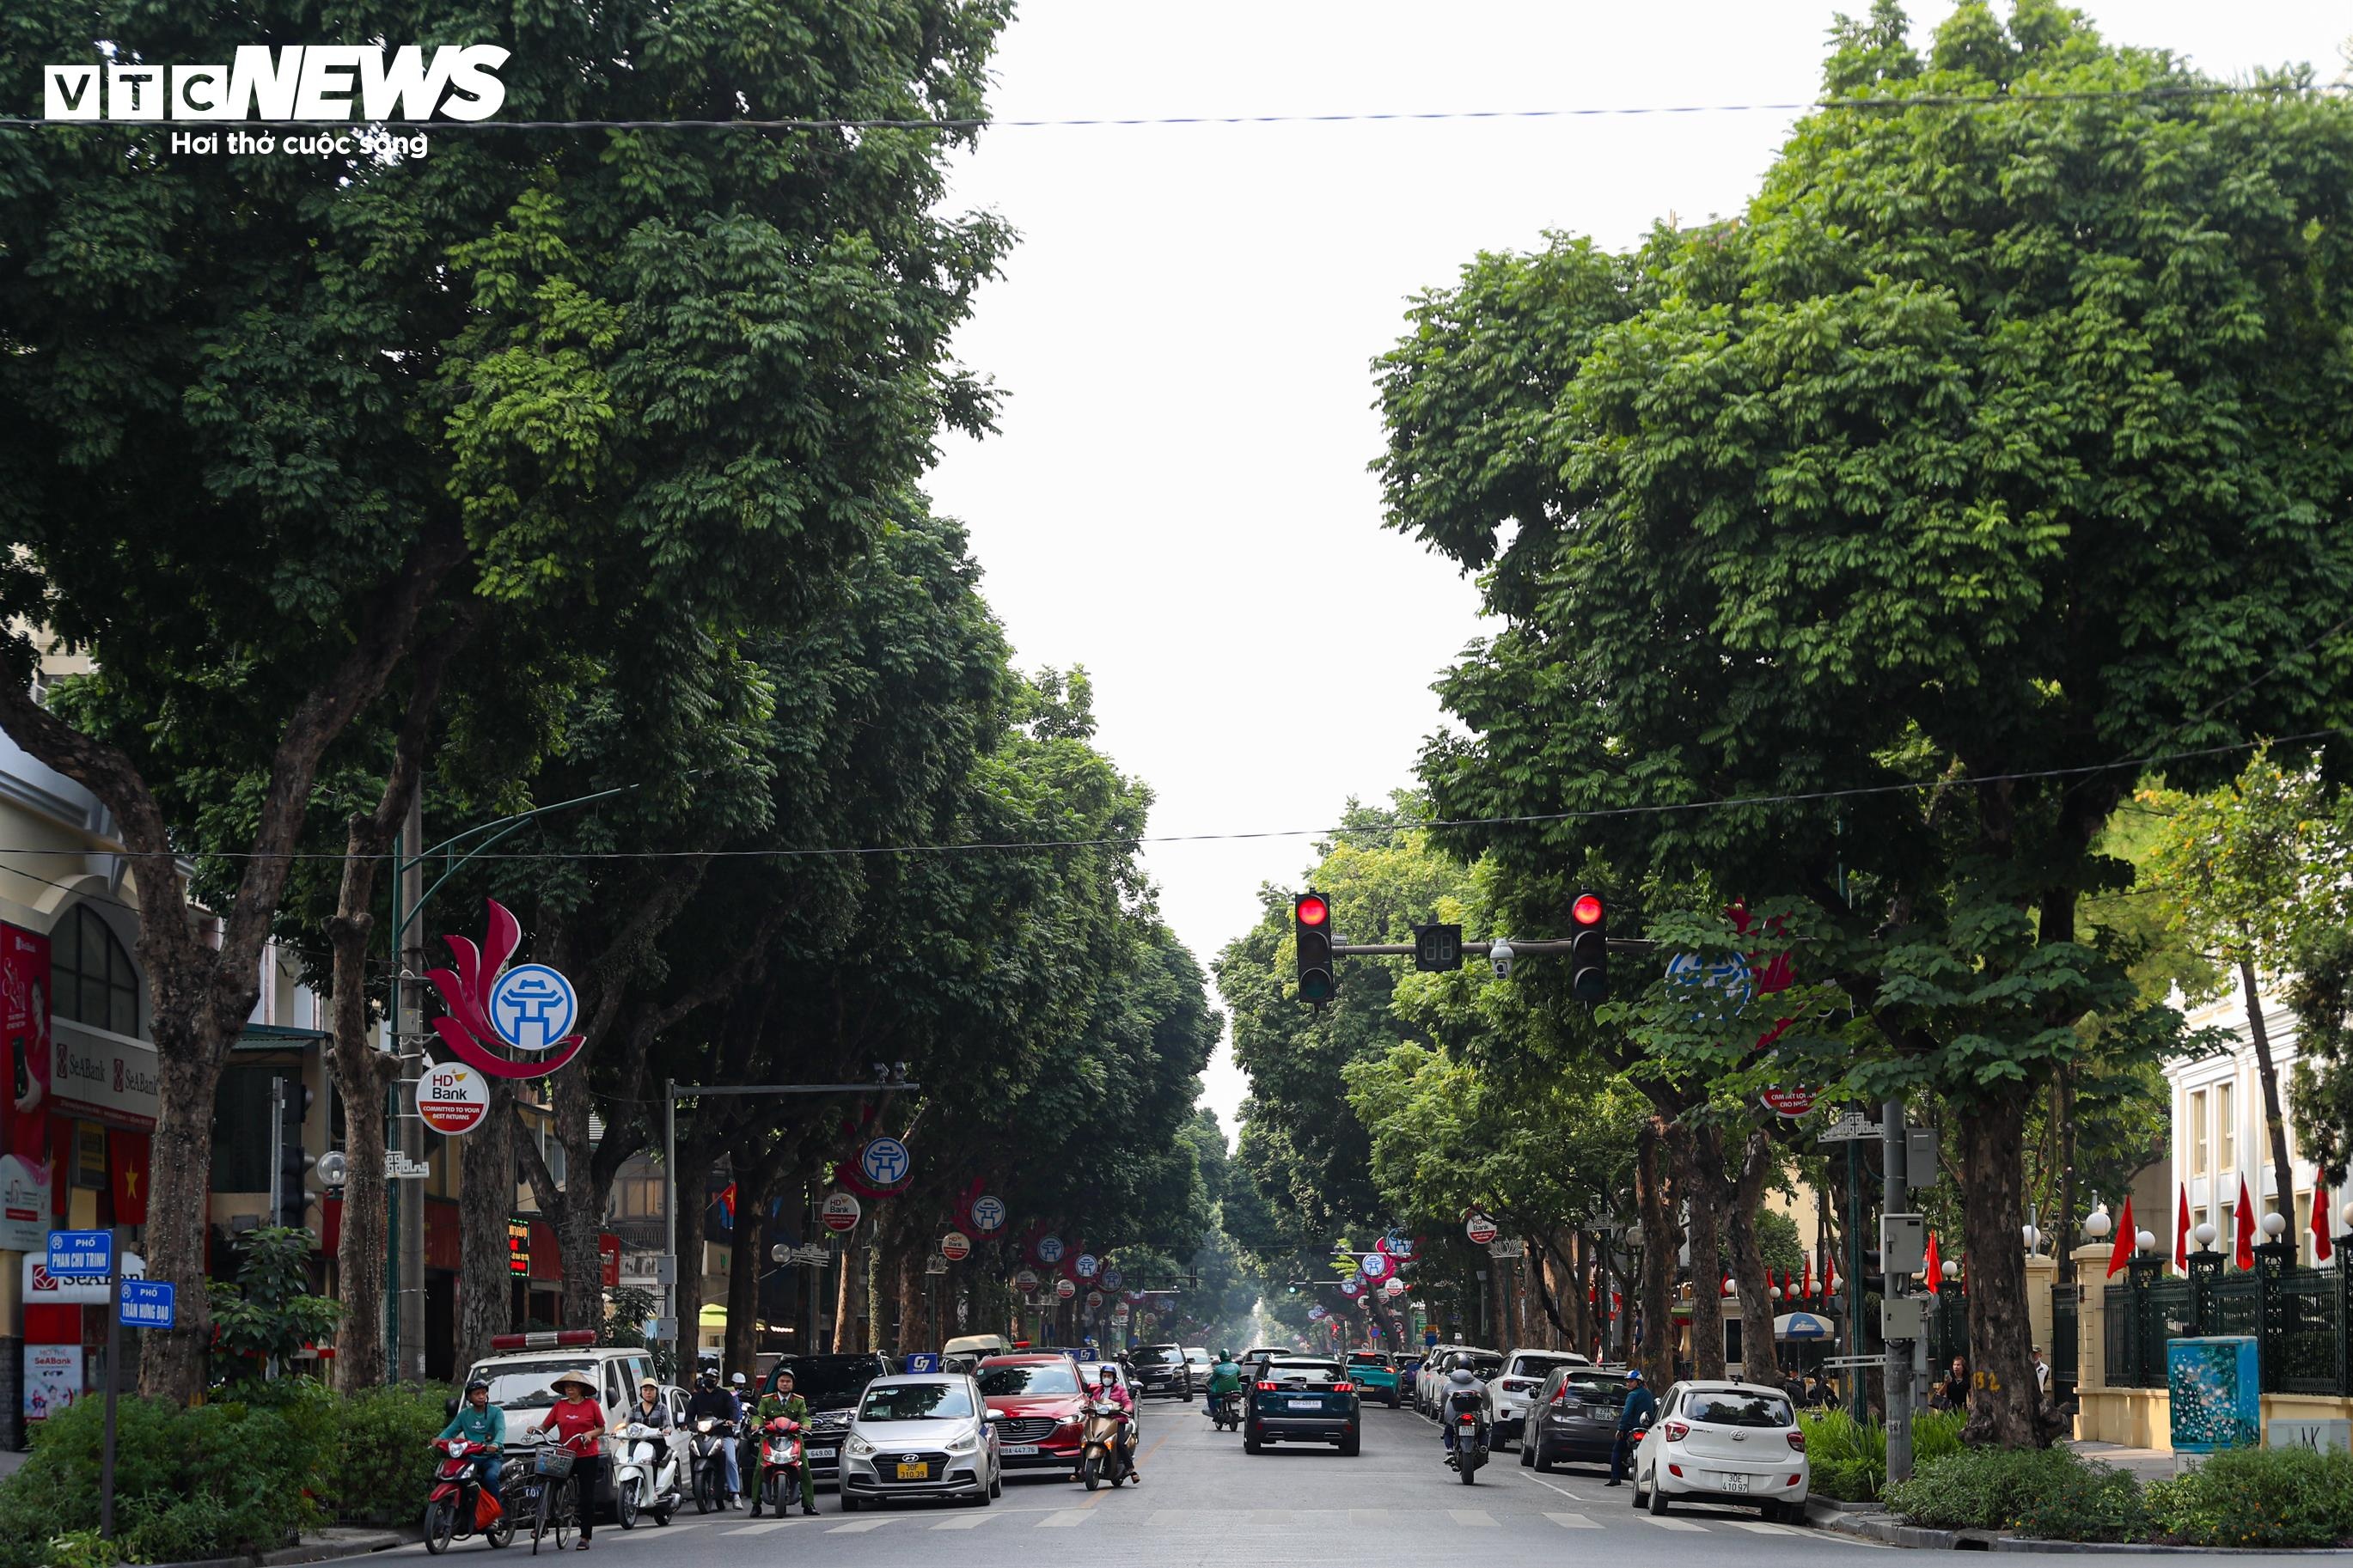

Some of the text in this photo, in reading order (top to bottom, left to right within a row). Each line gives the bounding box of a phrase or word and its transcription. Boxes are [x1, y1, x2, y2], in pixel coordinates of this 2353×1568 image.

[70, 1053, 105, 1082] SeABank
[125, 1068, 158, 1096] SeABank
[432, 1074, 453, 1087] HD
[432, 1087, 468, 1101] Bank
[76, 1235, 96, 1248] PHỐ
[52, 1253, 107, 1268] PHAN CHU TRINH
[139, 1286, 158, 1297] PHỐ
[913, 1356, 930, 1371] G7
[1727, 1473, 1742, 1483] 30E
